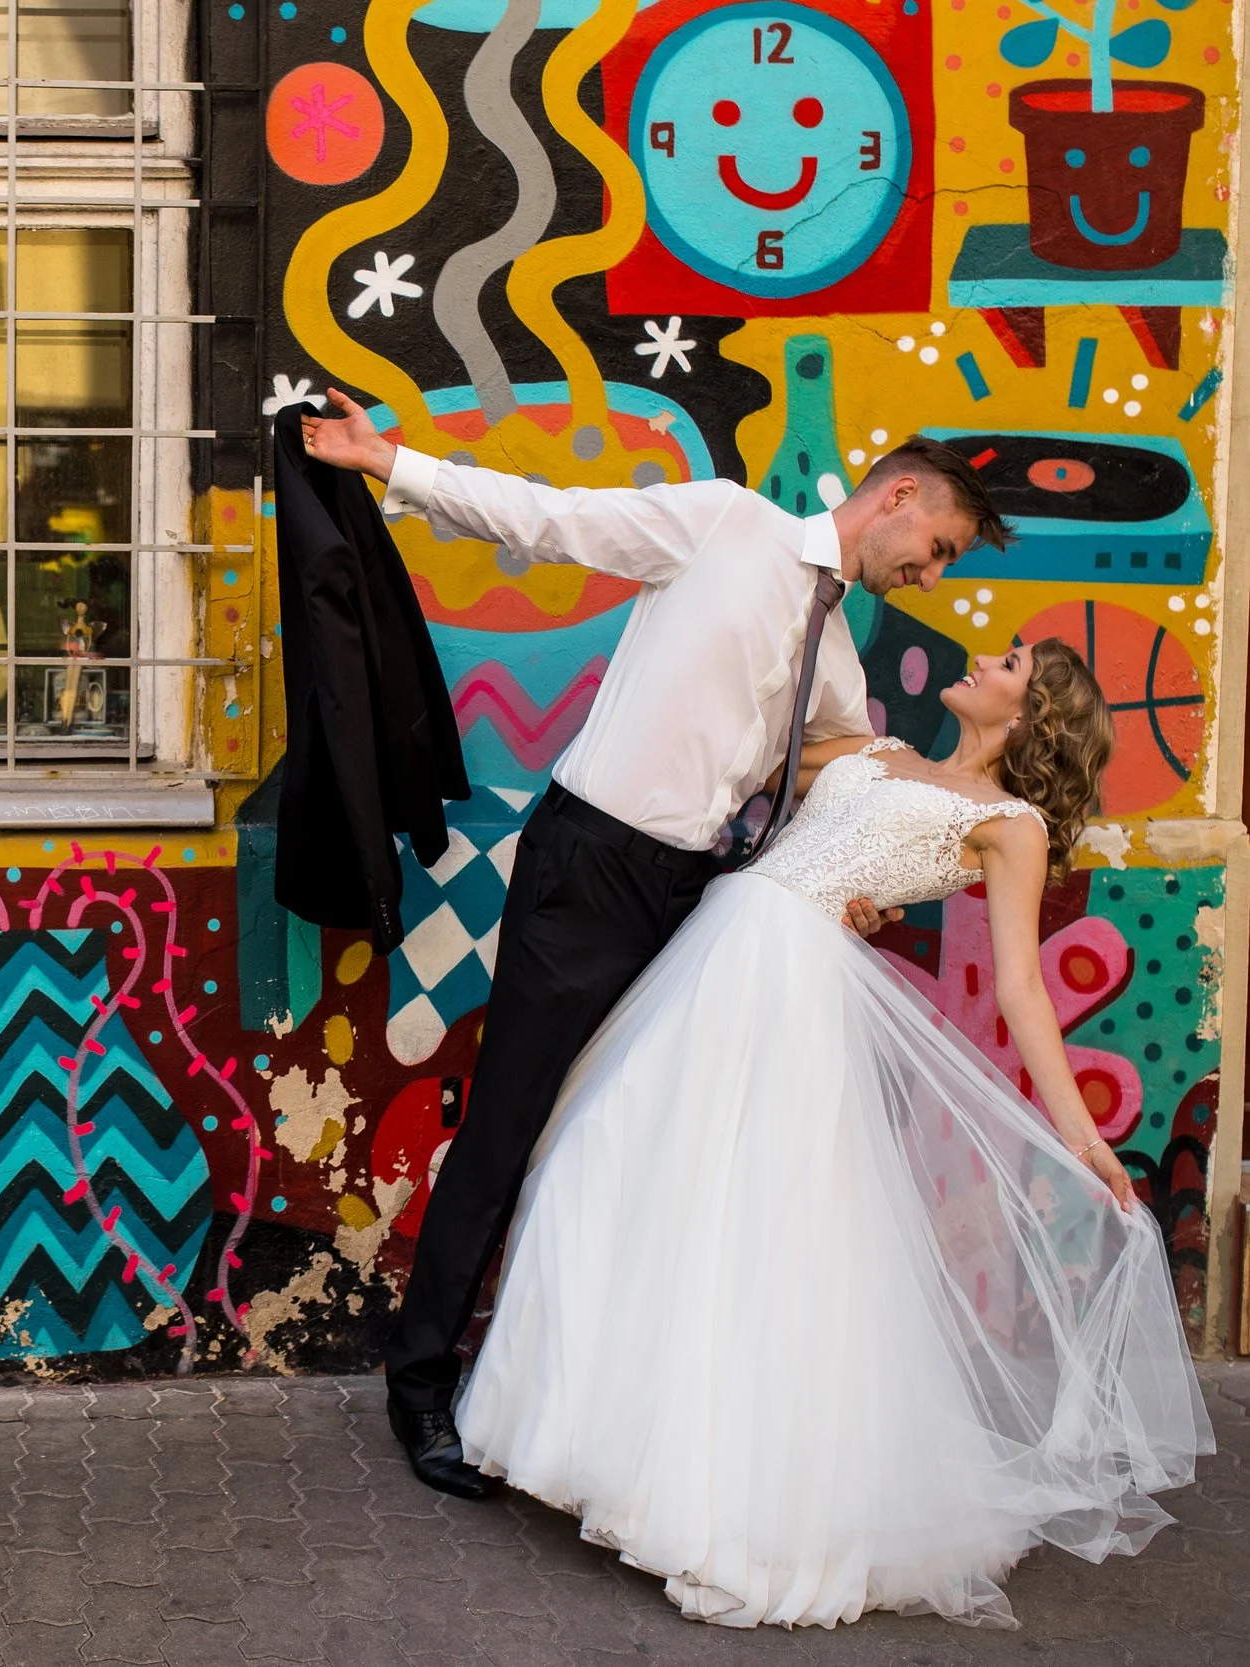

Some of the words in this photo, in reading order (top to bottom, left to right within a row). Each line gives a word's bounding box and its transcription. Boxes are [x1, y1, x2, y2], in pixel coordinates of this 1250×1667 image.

[753, 22, 794, 64] 12
[650, 122, 675, 158] 9
[859, 131, 881, 170] 3
[756, 230, 784, 270] 6
